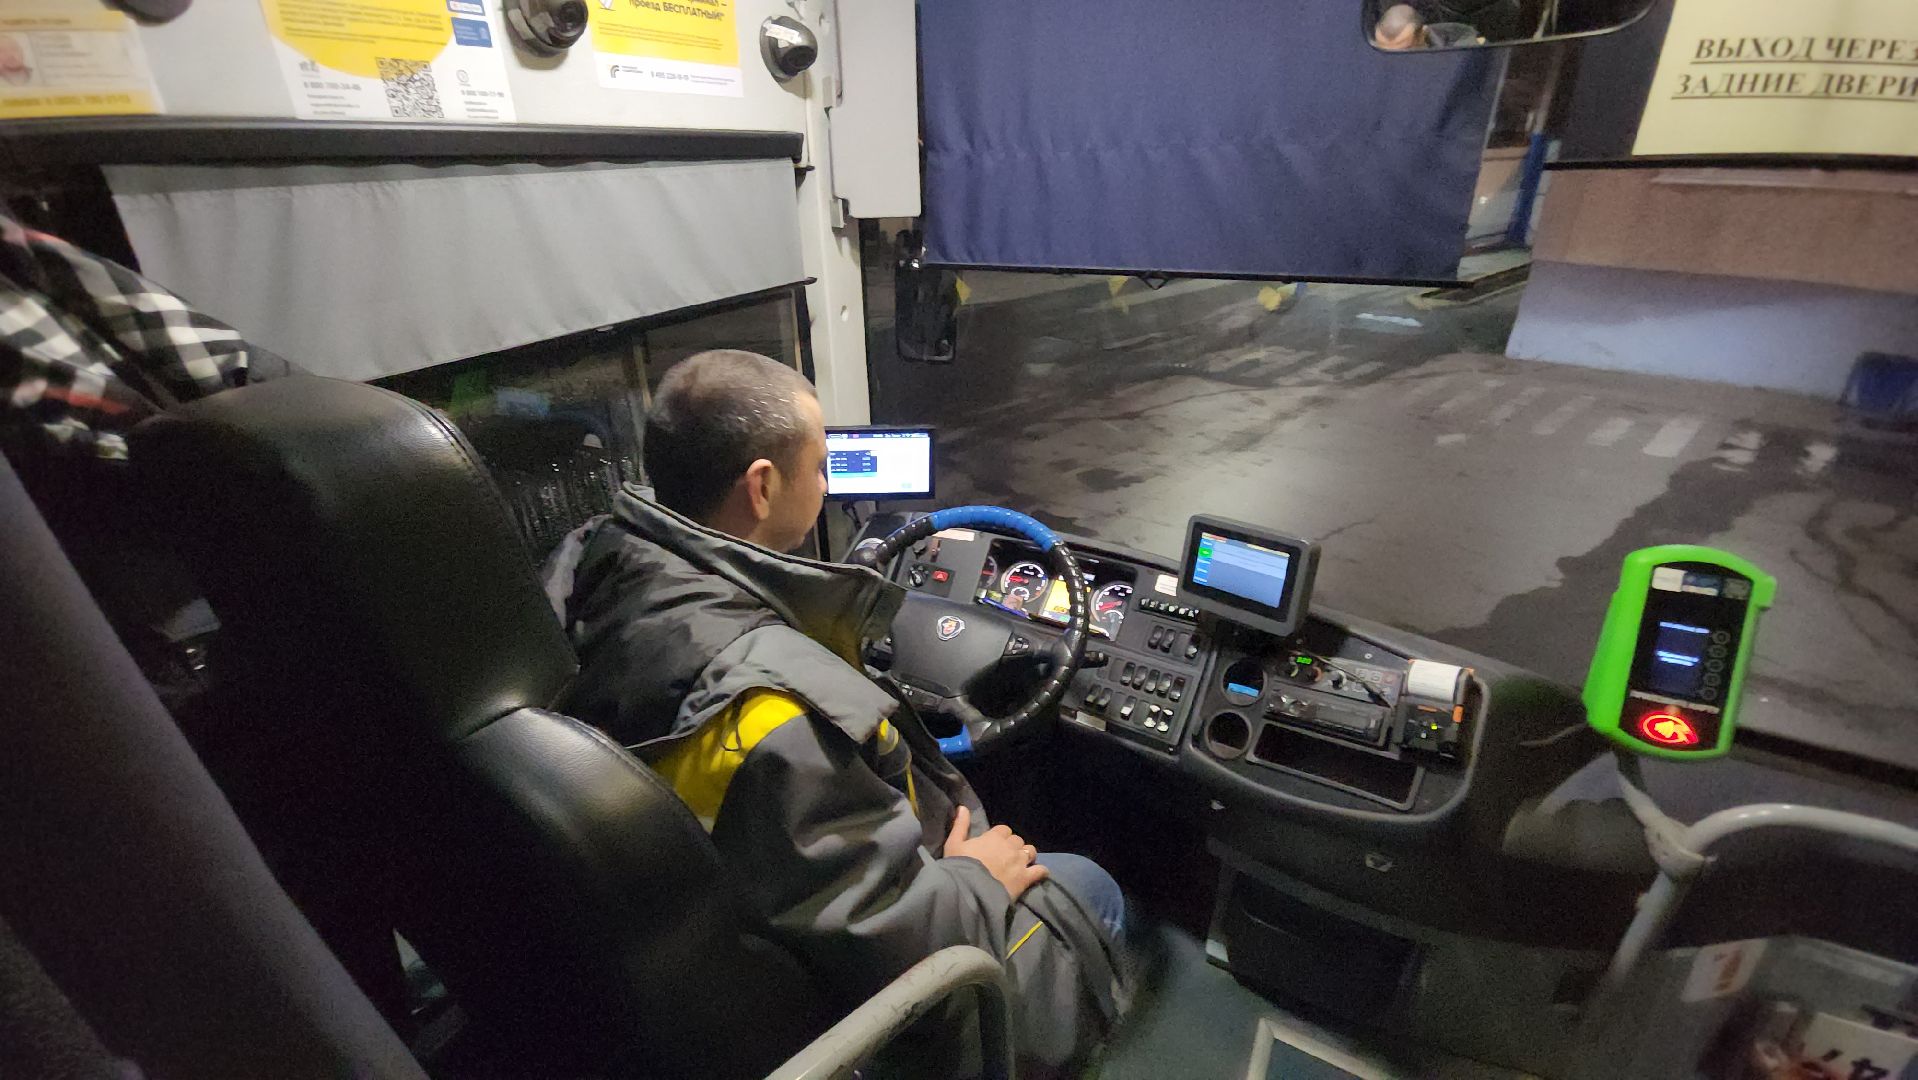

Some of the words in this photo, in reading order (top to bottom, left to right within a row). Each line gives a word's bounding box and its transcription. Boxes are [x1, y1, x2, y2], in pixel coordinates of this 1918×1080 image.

[1694, 37, 1816, 60] ВЫХОД
[1676, 73, 1806, 97] ЗАДНИЕ
[1809, 73, 1918, 97] ДВЕРИ
